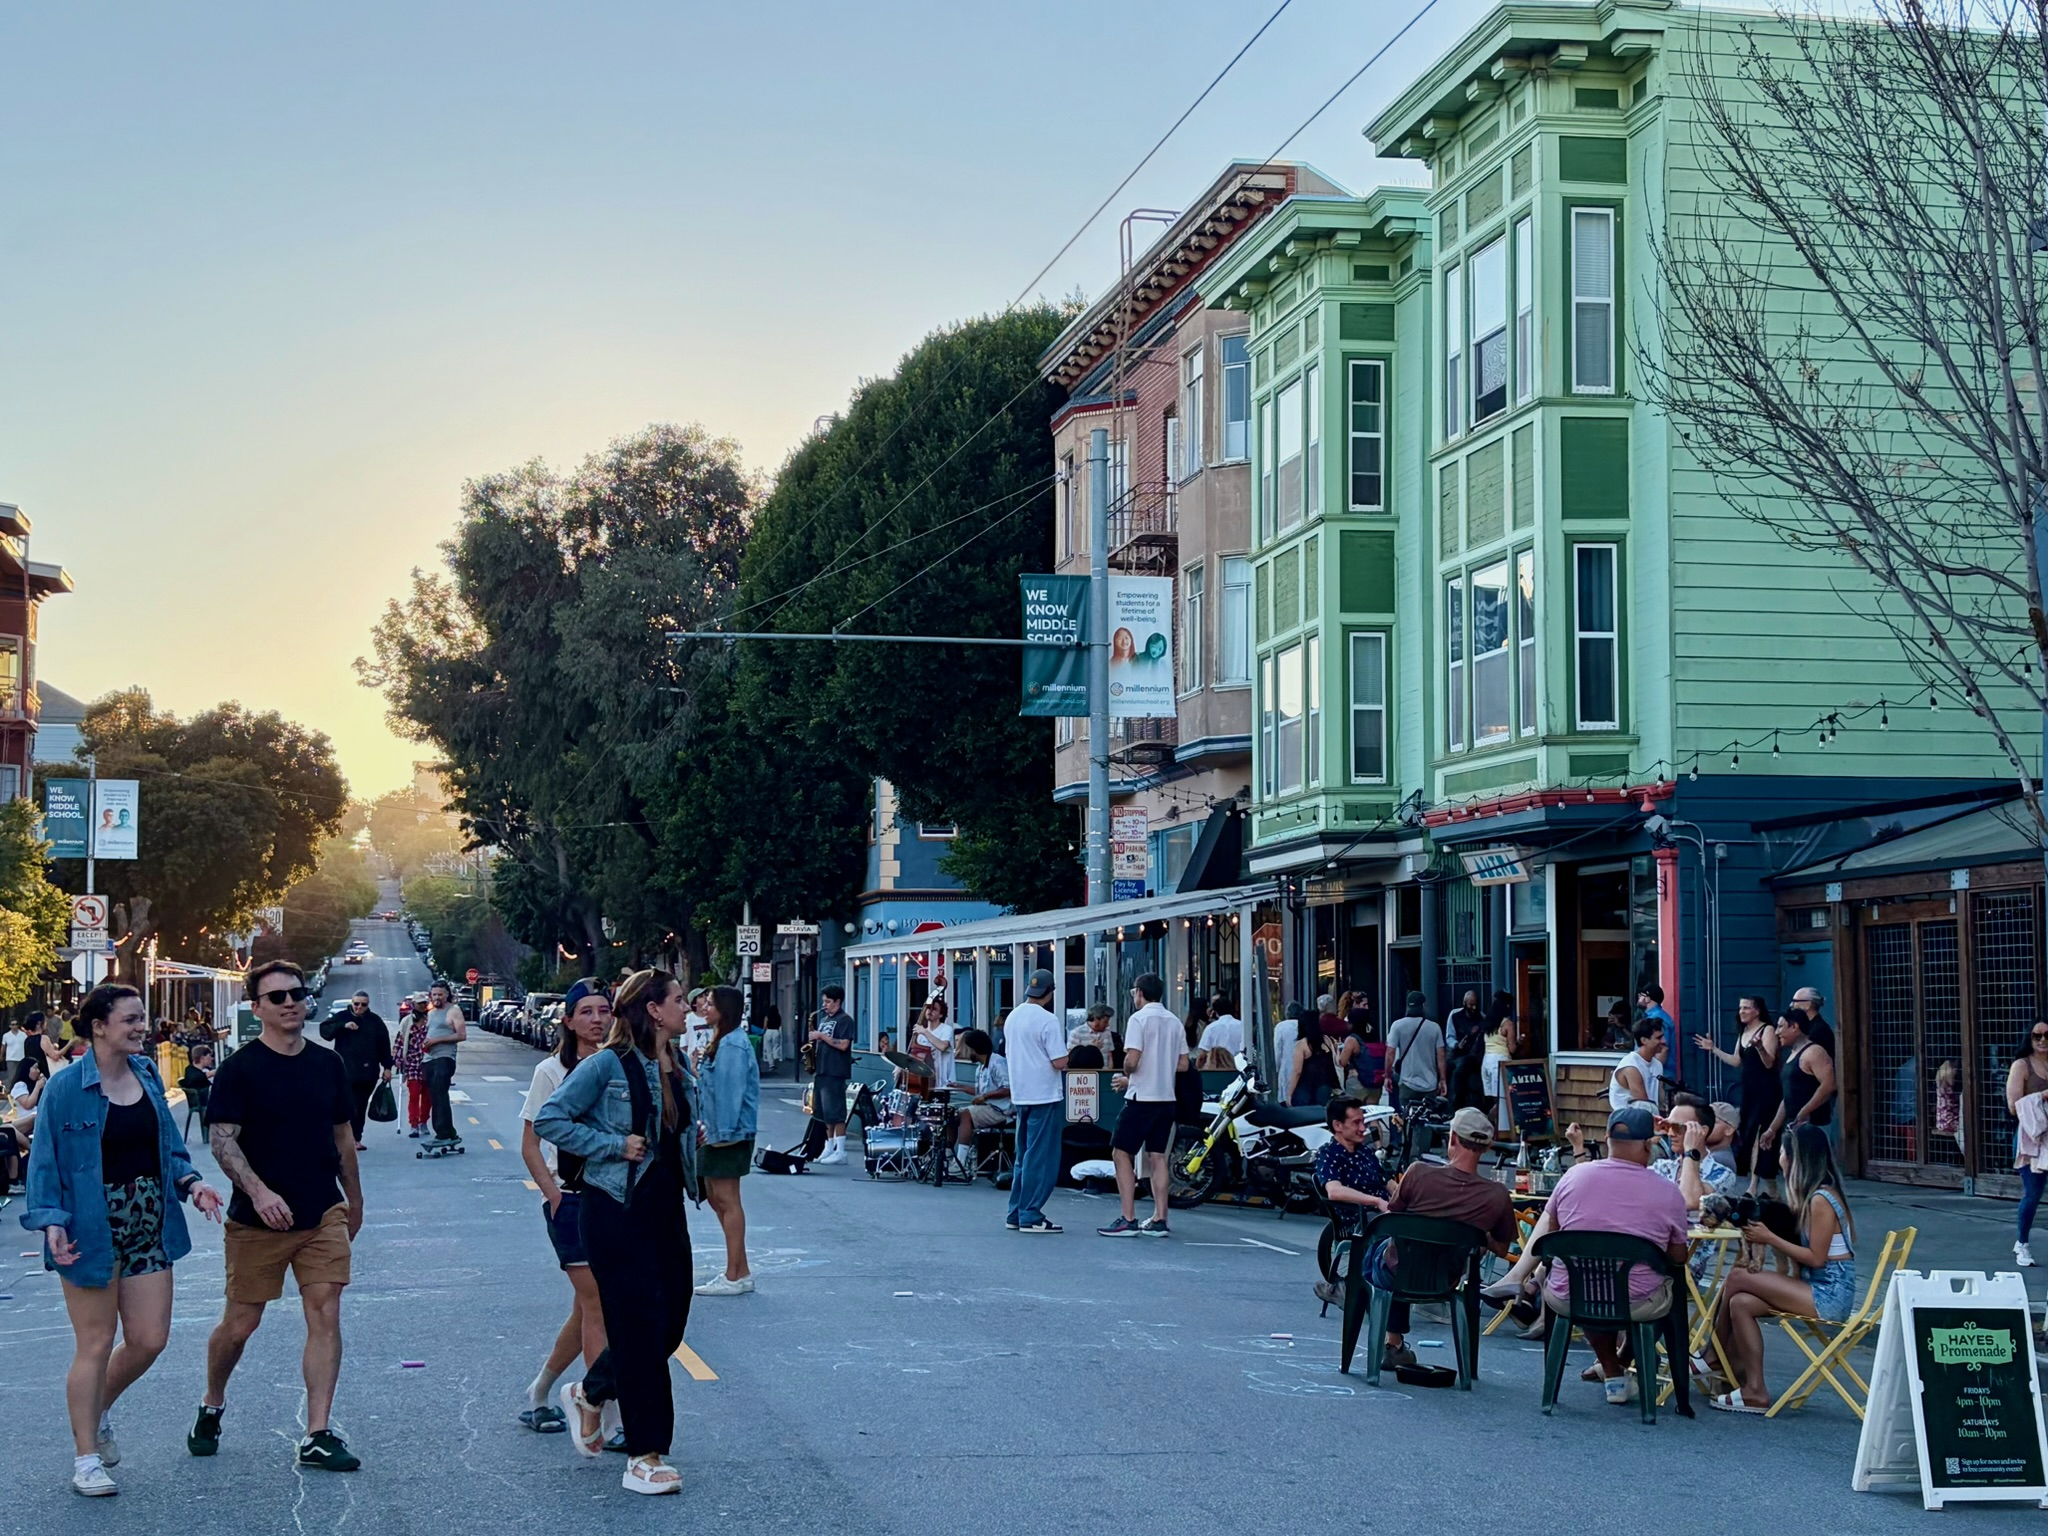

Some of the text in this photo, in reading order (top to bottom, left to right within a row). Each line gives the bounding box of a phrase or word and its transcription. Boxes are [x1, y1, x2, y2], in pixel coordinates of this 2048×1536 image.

[1026, 590, 1048, 601] WE
[1117, 591, 1159, 600] Empowering
[1026, 604, 1069, 616] KNOW
[1026, 619, 1077, 630] MIDDLE
[1042, 684, 1087, 692] millennium
[1125, 684, 1170, 693] millennium
[48, 803, 80, 811] MIDDLE
[1113, 807, 1147, 817] NO STOPPING
[1114, 843, 1147, 853] NO PARKING
[1127, 880, 1137, 888] by
[739, 941, 759, 953] 20
[1076, 1075, 1088, 1085] NO
[1069, 1086, 1096, 1096] PARKING
[1074, 1099, 1090, 1107] FIRE
[1074, 1108, 1091, 1116] LANE
[1948, 1334, 1995, 1346] HAYES
[1939, 1343, 2007, 1357] Promenade
[1963, 1387, 1991, 1395] FRIDAYS
[1961, 1458, 1973, 1466] Sign
